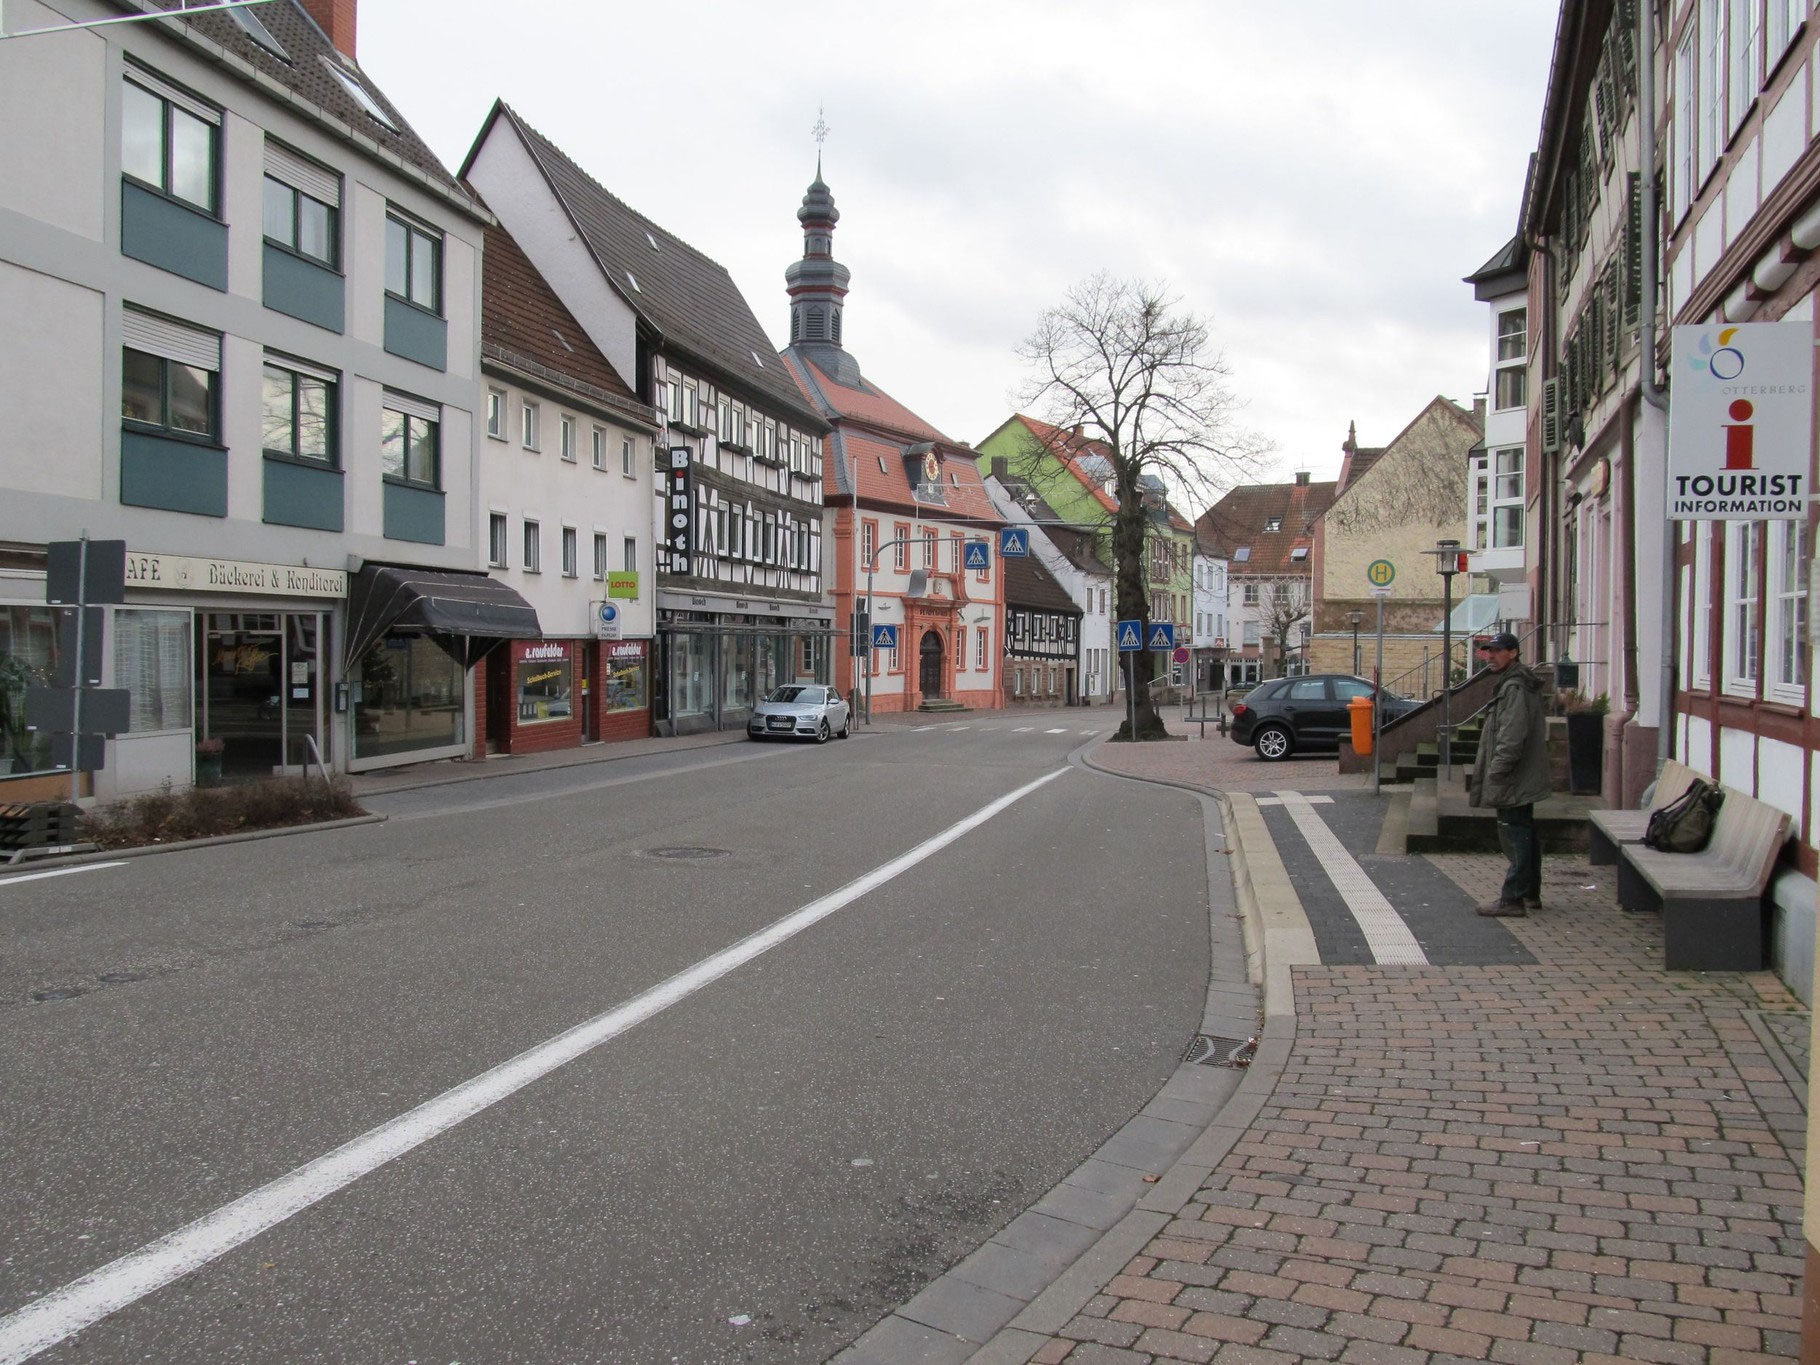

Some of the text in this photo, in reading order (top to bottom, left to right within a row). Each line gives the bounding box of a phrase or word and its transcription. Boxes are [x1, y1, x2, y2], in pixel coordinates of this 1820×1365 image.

[1722, 385, 1806, 395] OTTERBERG
[1719, 399, 1760, 470] i
[1675, 474, 1803, 497] TOURIST
[671, 450, 689, 572] Binoth
[1674, 500, 1802, 513] INFORMATION
[208, 563, 265, 587] Bäckerei
[271, 570, 280, 588] &
[287, 569, 343, 594] Konditorei
[1375, 565, 1387, 581] H
[610, 581, 636, 589] LOTTO
